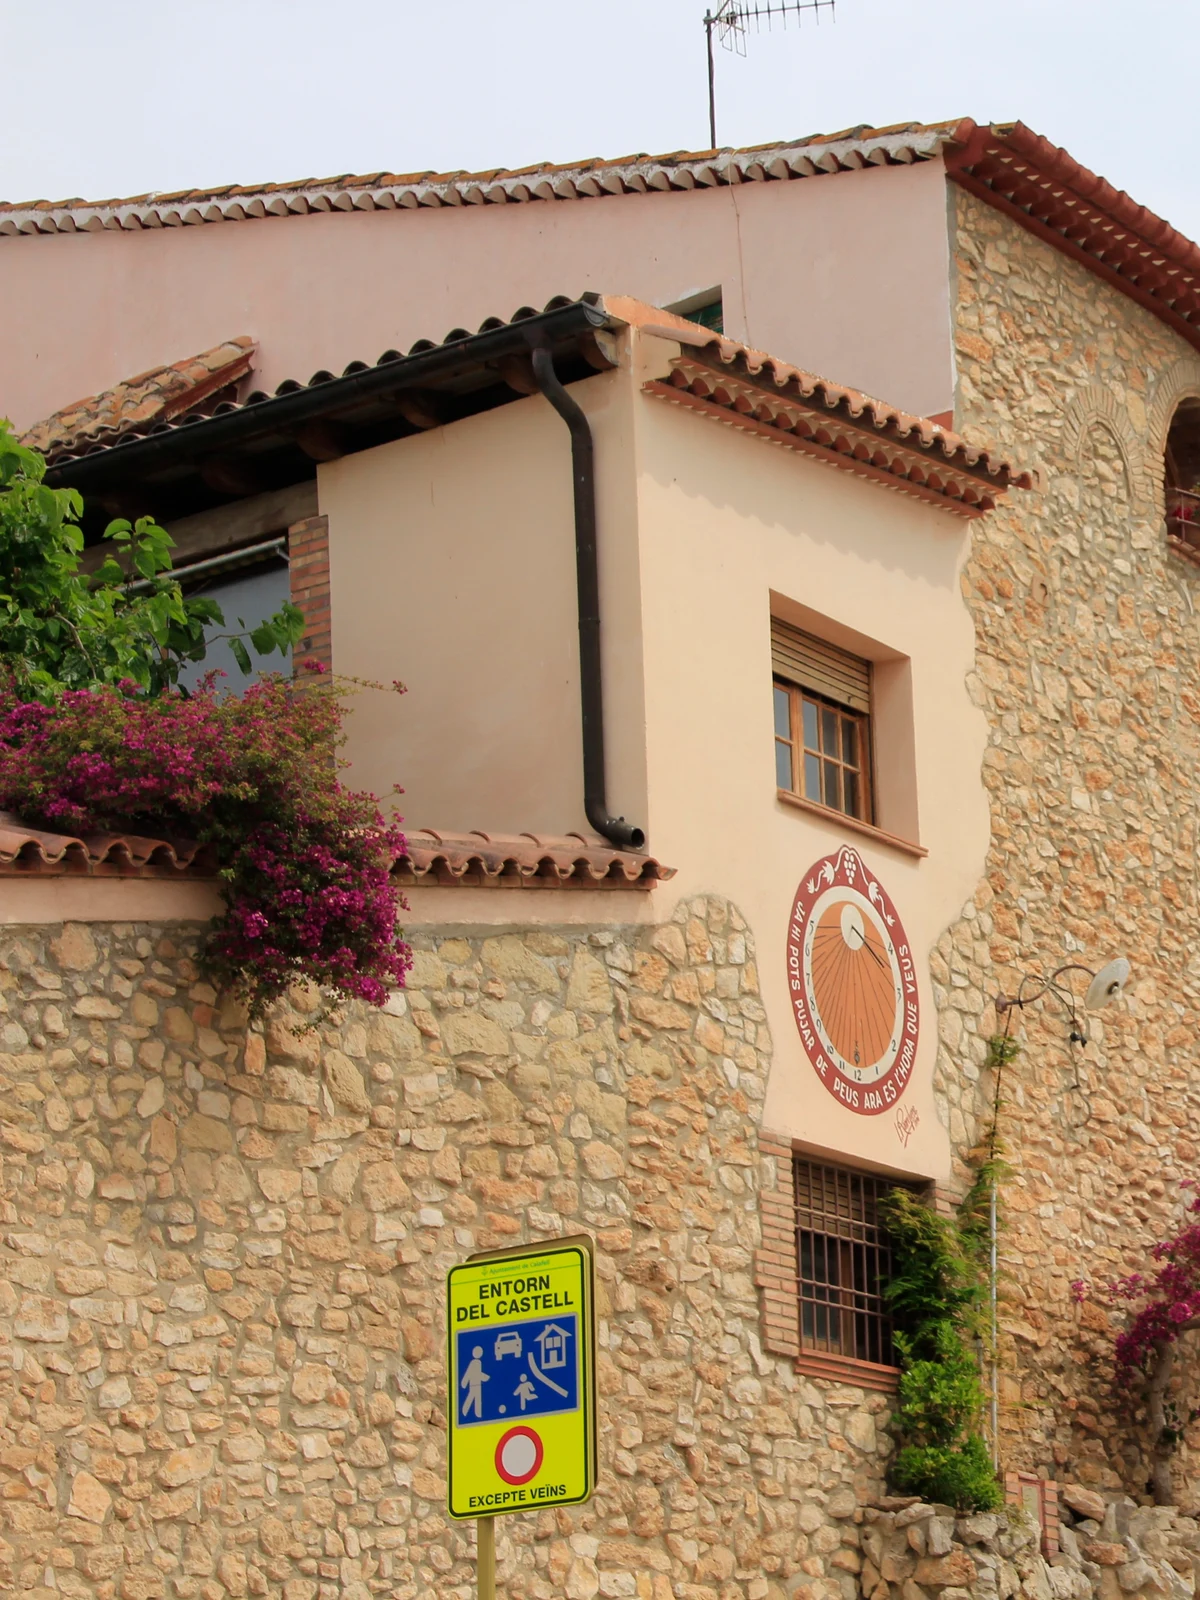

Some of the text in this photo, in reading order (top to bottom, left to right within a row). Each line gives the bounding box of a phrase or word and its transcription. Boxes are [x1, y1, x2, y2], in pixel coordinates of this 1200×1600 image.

[794, 901, 806, 923] JA
[791, 924, 801, 941] HI
[804, 942, 811, 957] 6
[789, 944, 801, 990] POTS
[899, 944, 916, 993] VEUS
[805, 972, 811, 986] 7
[809, 996, 816, 1011] 8
[795, 999, 815, 1050] PUJAR
[816, 1018, 822, 1033] 9
[906, 1000, 918, 1035] QUE
[891, 1039, 897, 1052] 2
[815, 1054, 829, 1077] DE
[894, 1038, 915, 1088] L'HORA
[854, 1069, 862, 1081] 12
[833, 1077, 859, 1108] PEUS
[864, 1090, 883, 1109] ARA
[882, 1080, 897, 1103] ES
[479, 1275, 549, 1299] ENTORN
[457, 1291, 574, 1322] DEL CASTELL
[469, 1484, 567, 1507] EXCEPTE VEÏNS
